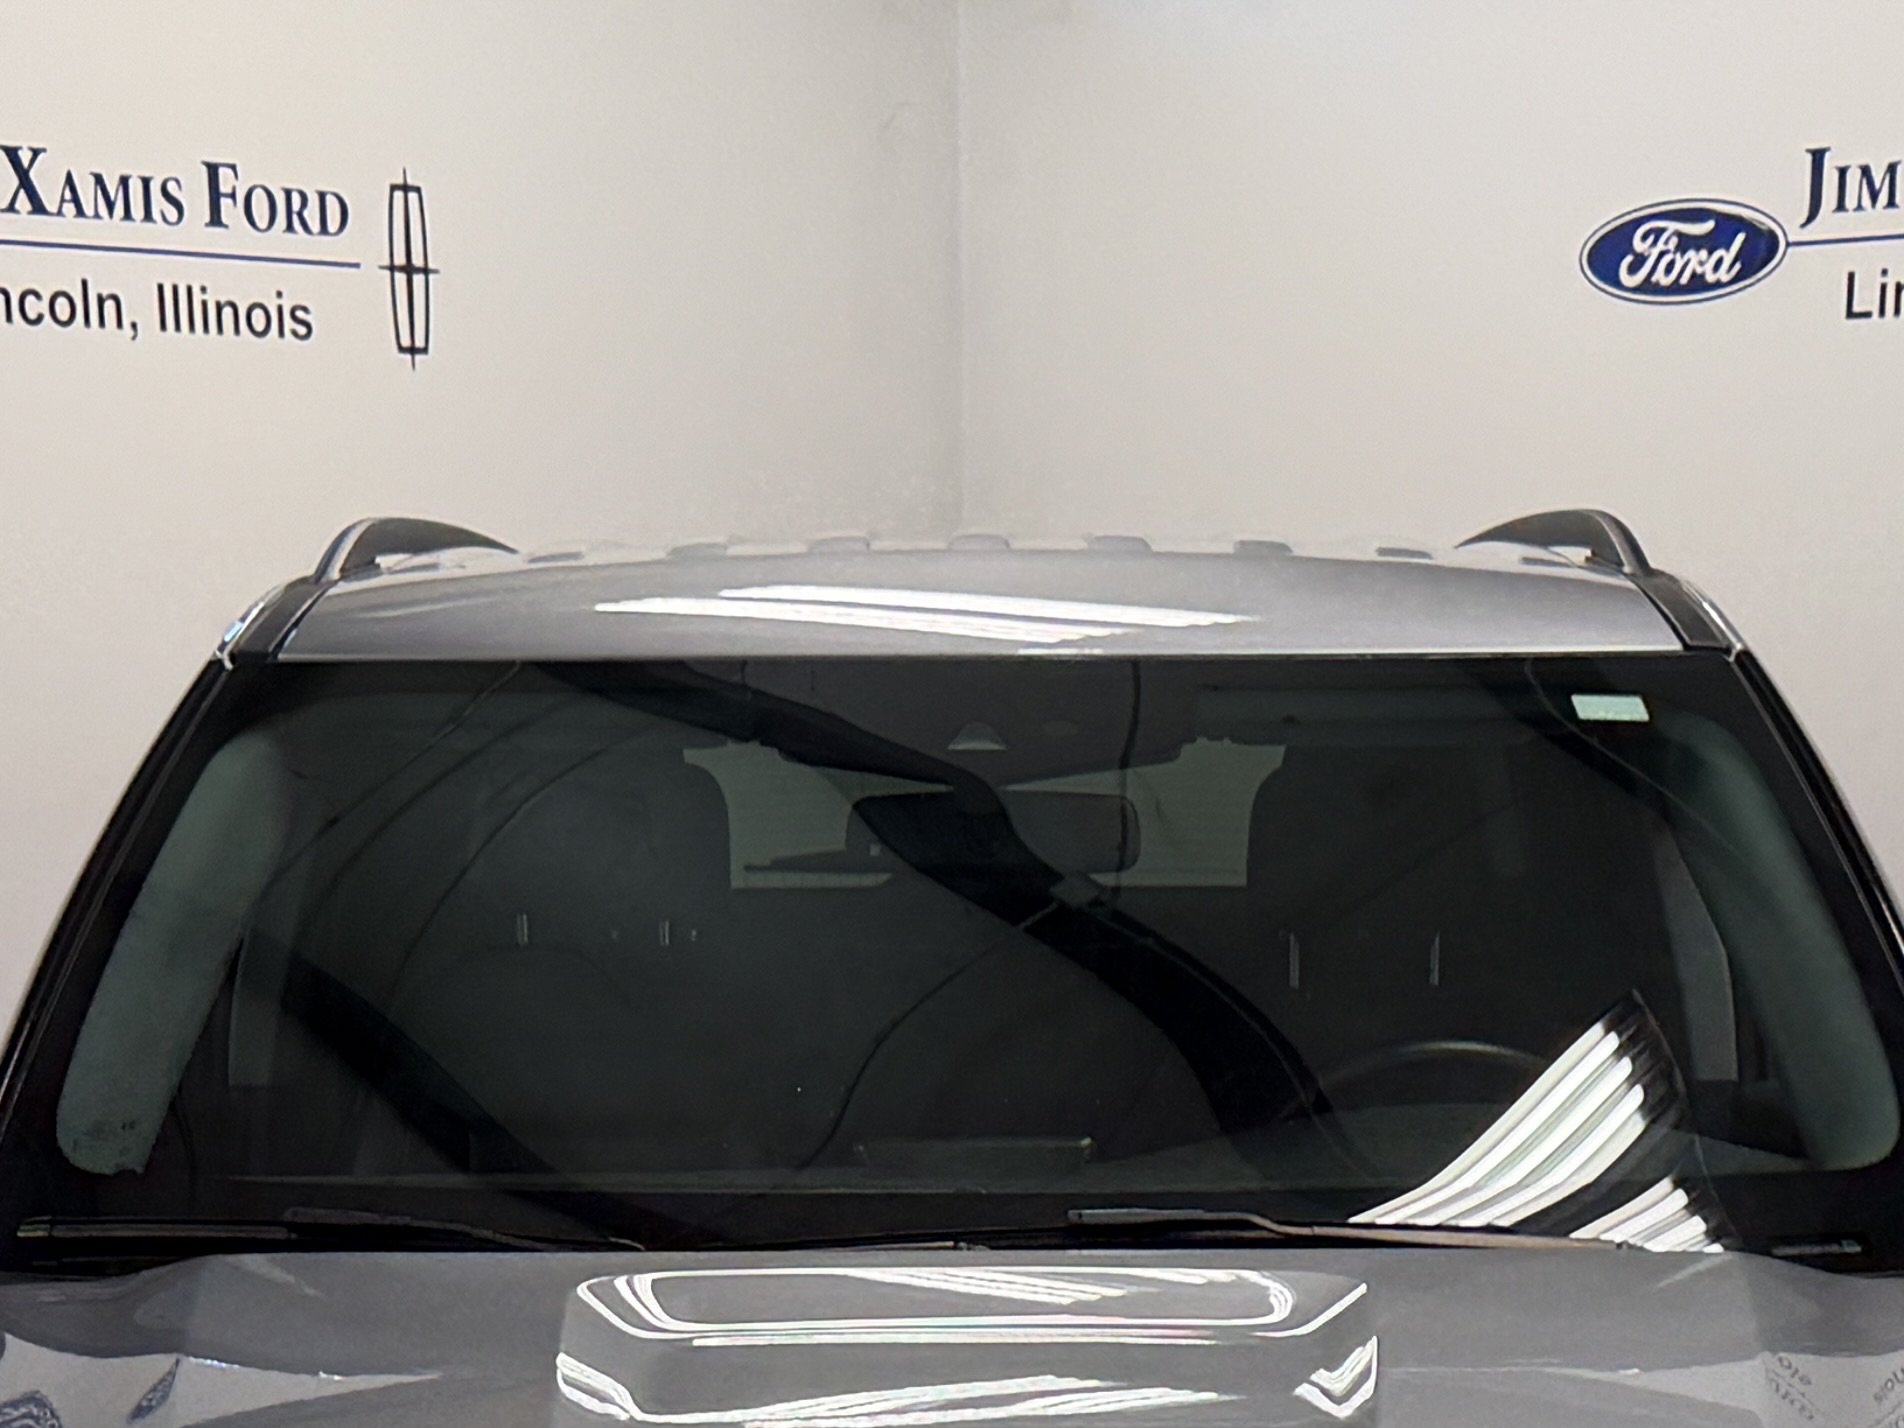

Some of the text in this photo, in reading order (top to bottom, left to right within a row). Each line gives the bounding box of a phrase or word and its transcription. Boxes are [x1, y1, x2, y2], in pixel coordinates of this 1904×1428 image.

[202, 161, 348, 236] FORD
[1800, 147, 1901, 228] JIM
[1619, 216, 1745, 289] Ford
[157, 283, 312, 340] Illinois
